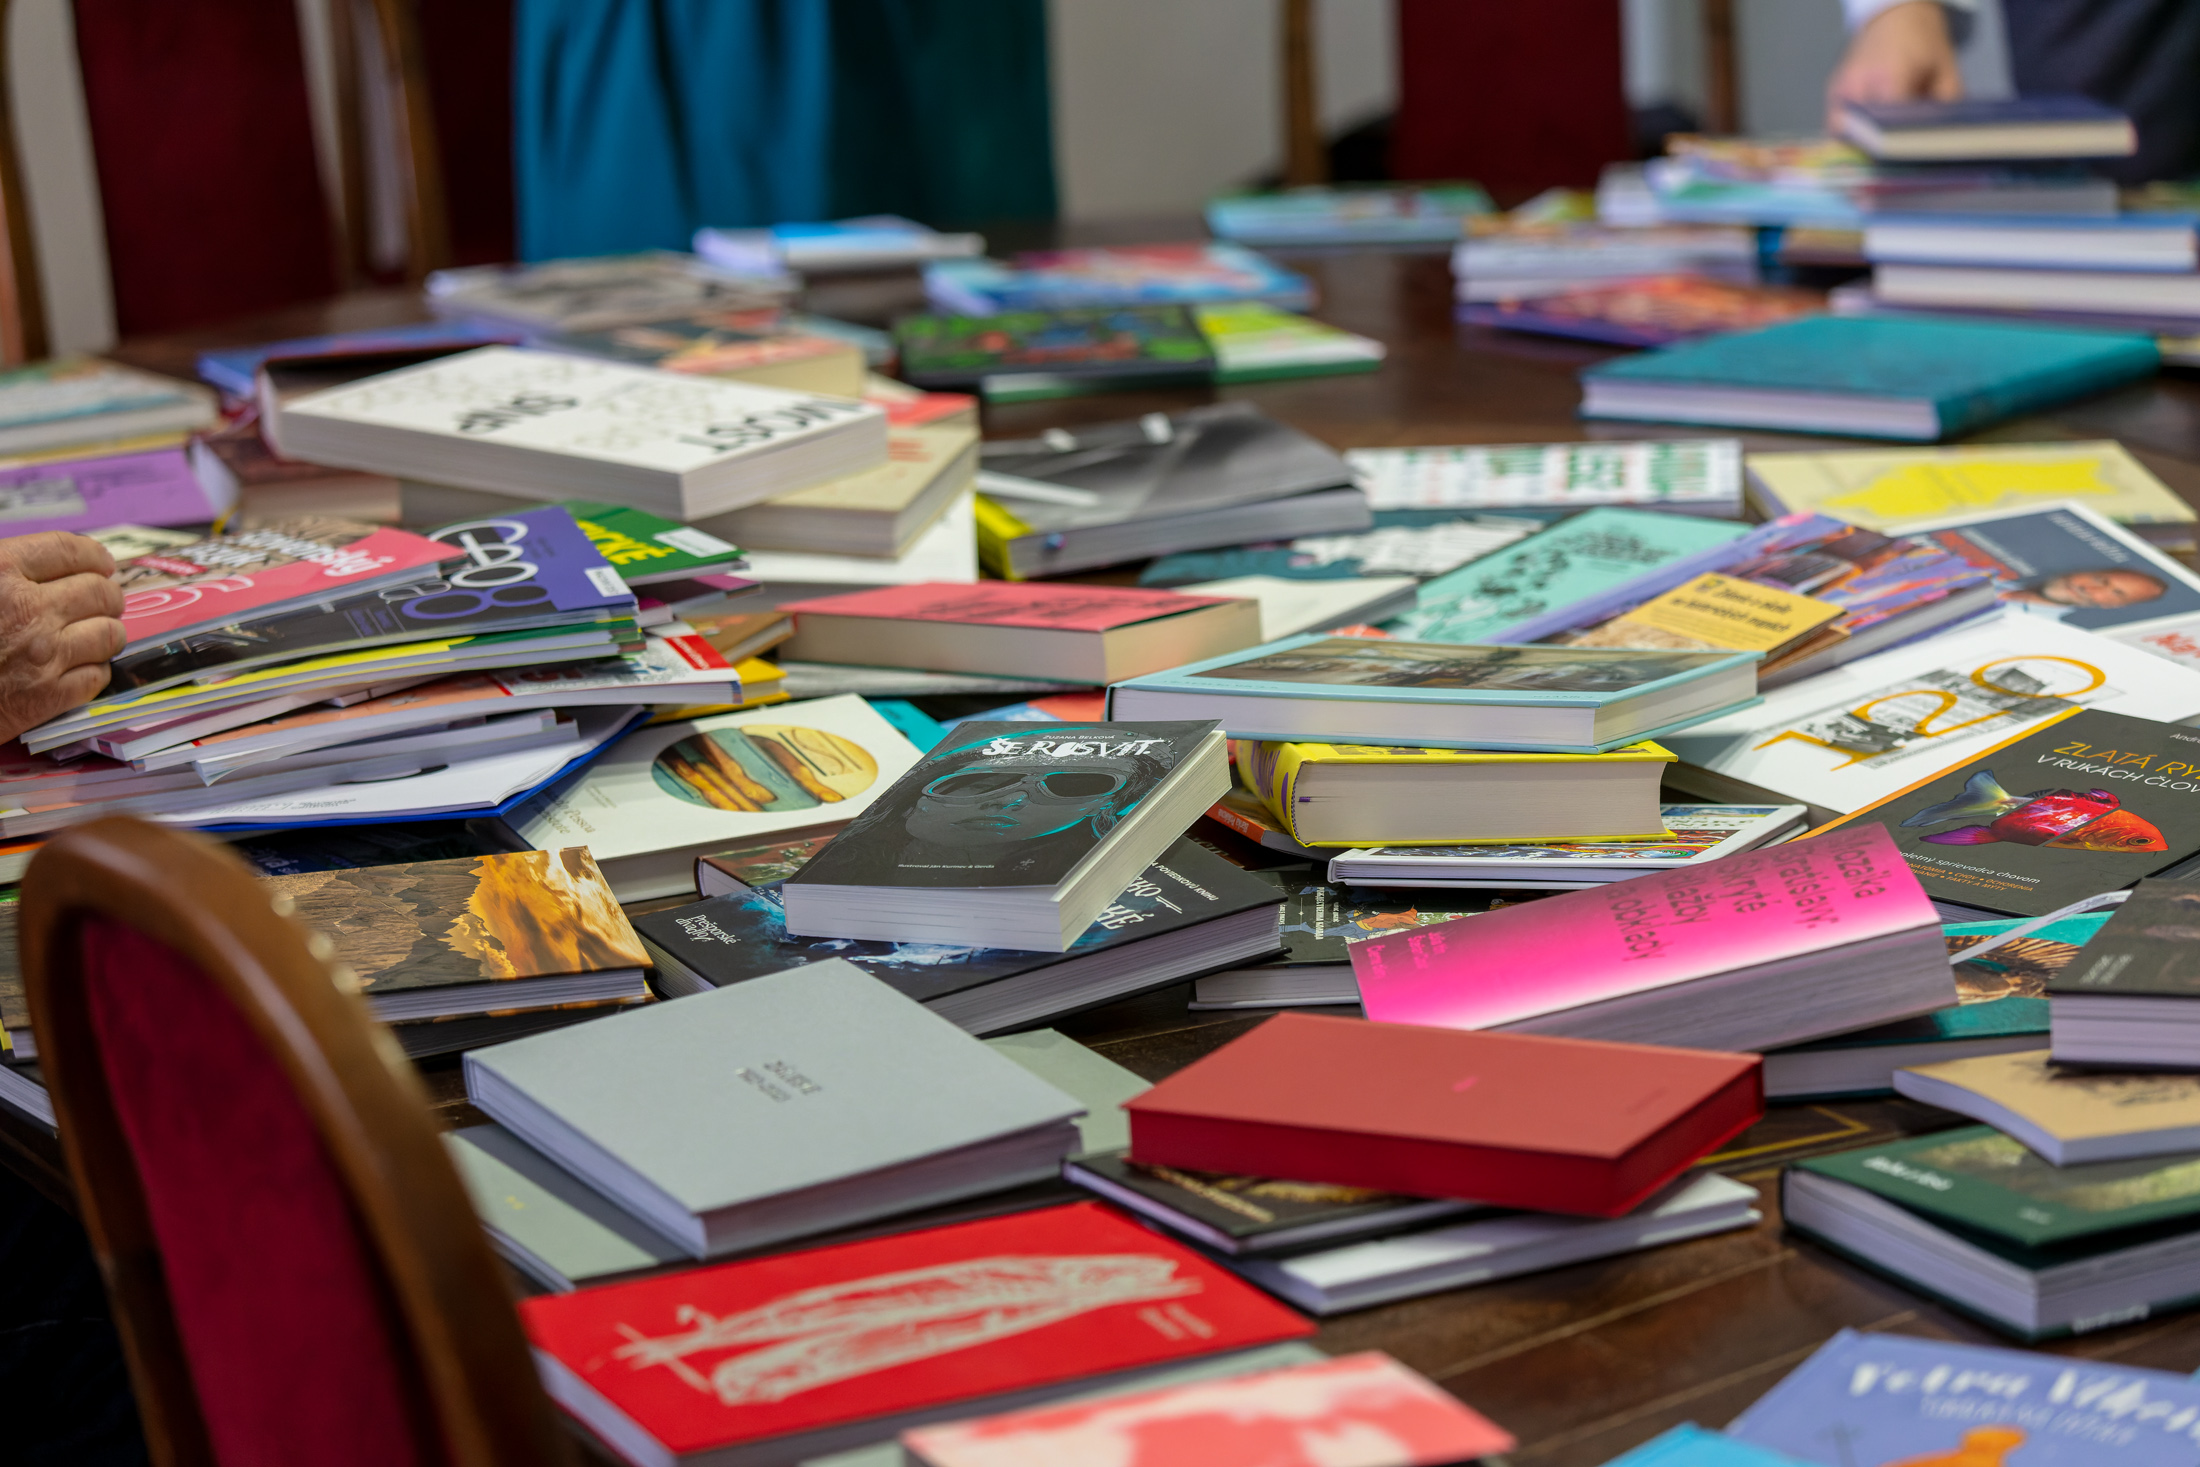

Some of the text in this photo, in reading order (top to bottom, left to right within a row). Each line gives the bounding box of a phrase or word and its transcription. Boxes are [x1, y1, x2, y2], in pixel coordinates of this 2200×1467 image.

[1752, 655, 2106, 772] 120
[2169, 731, 2200, 745] Andr
[2037, 754, 2056, 764] V
[2052, 758, 2144, 782] RUKÁCH
[2053, 741, 2158, 769] ZLATÁ
[1935, 858, 1995, 875] sprievodca
[1996, 871, 2041, 884] chovom
[1985, 878, 2034, 892] OCHORENIA
